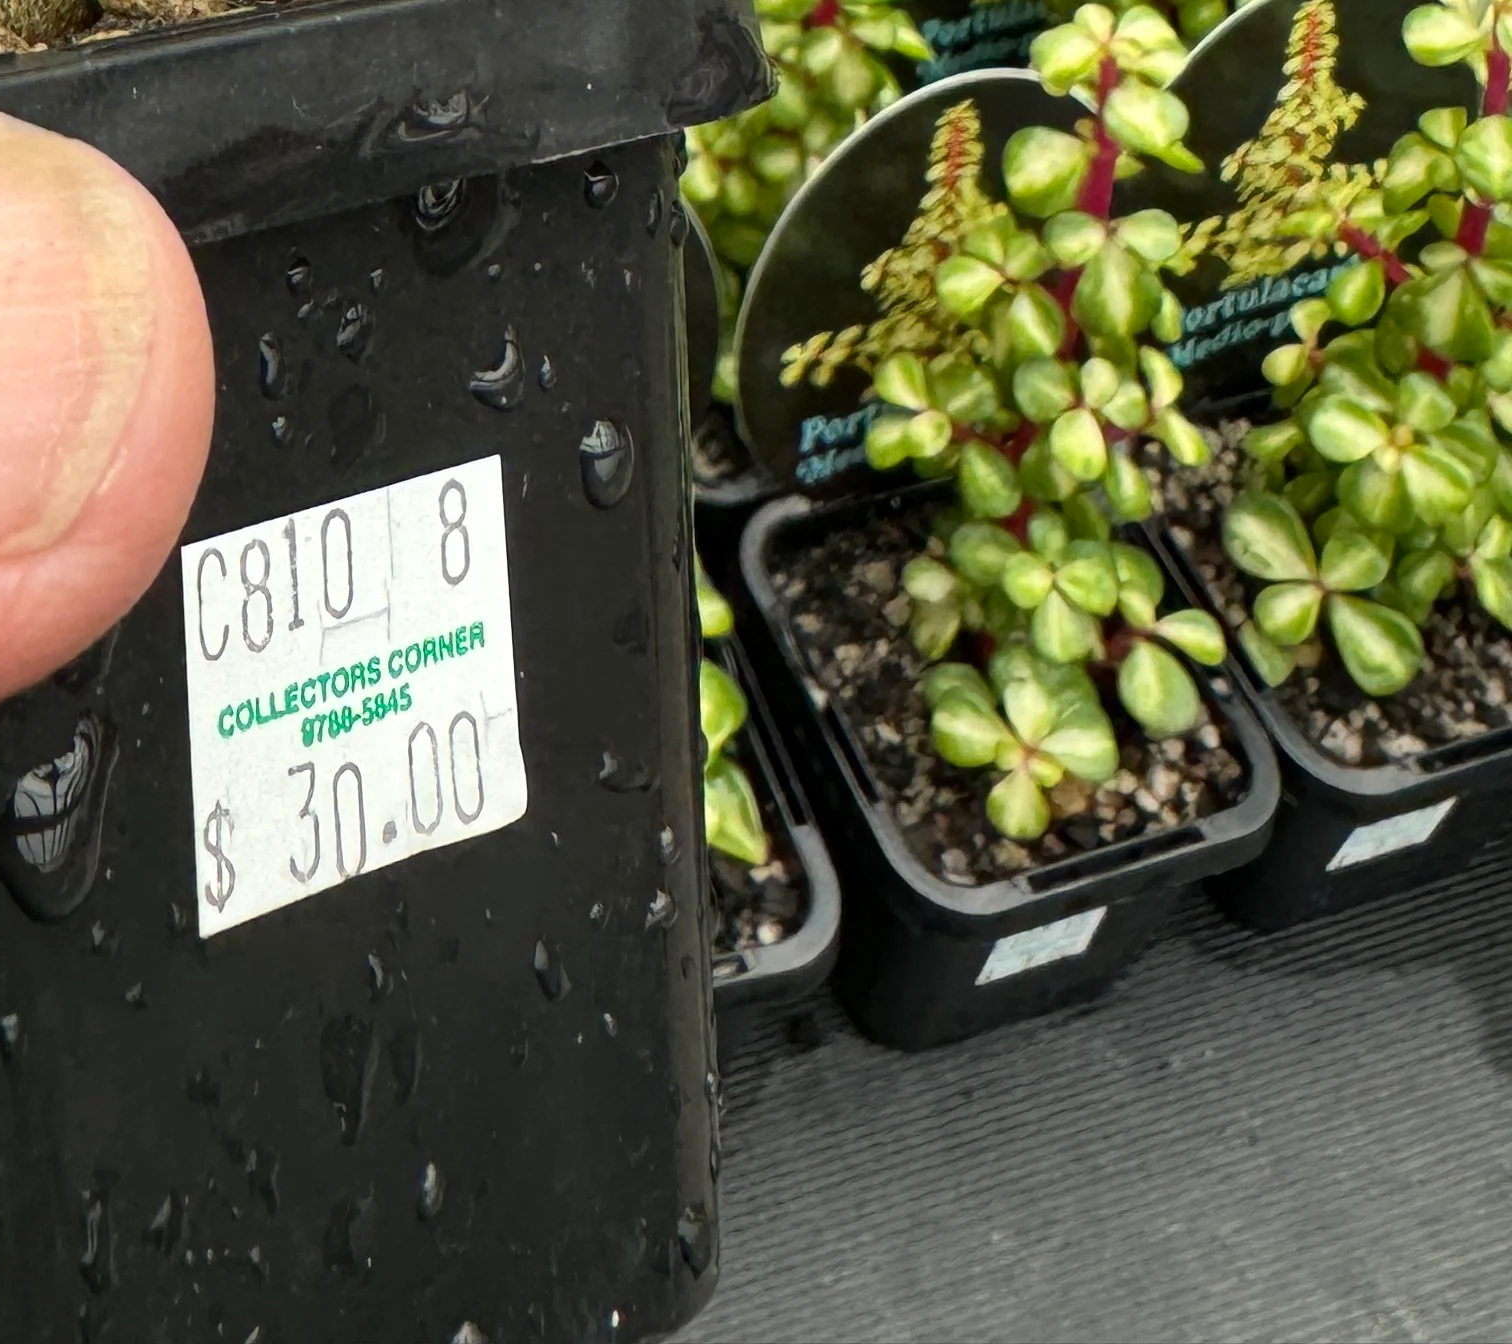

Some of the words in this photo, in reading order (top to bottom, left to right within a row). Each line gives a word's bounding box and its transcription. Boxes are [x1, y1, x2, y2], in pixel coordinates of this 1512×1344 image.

[197, 507, 354, 661] C810
[438, 477, 471, 587] 8
[217, 655, 382, 740] COLLECTORS
[388, 620, 486, 680] CORNER
[203, 799, 236, 914] $
[288, 710, 485, 884] 30.00
